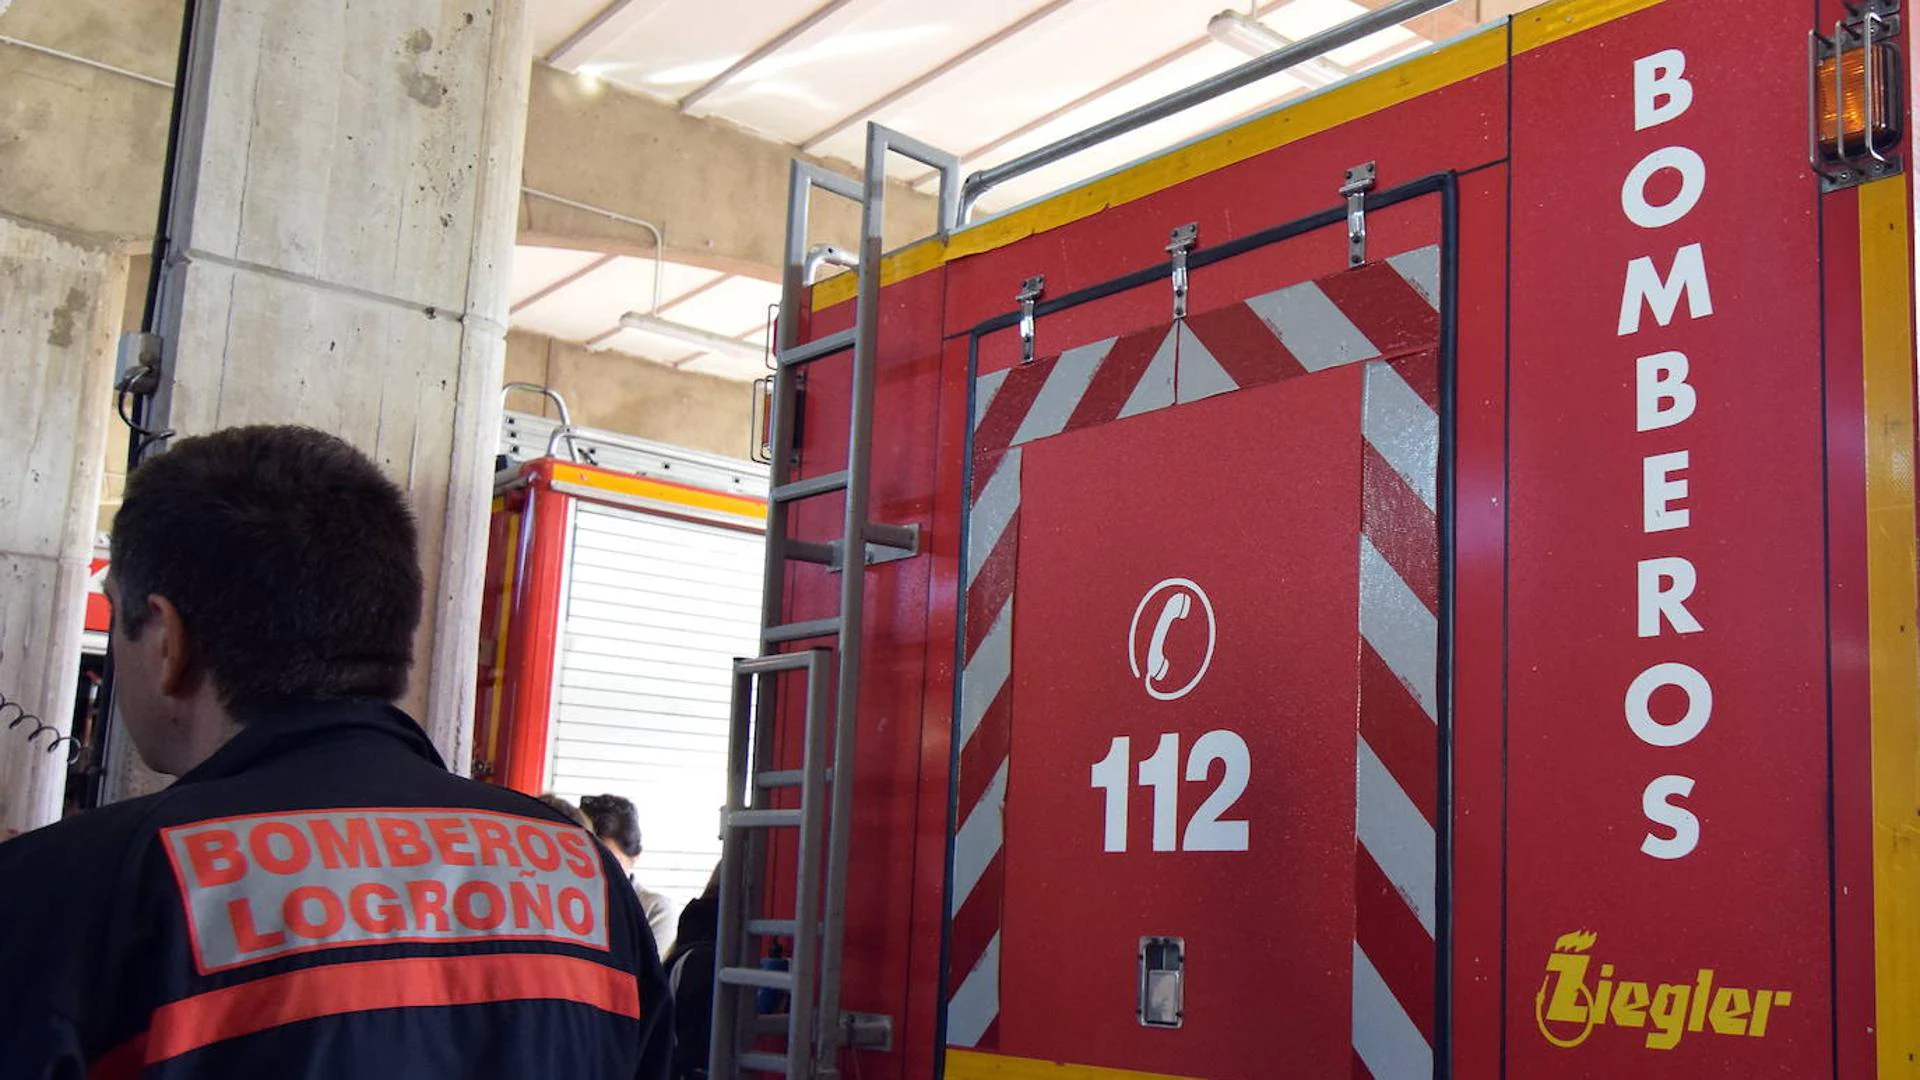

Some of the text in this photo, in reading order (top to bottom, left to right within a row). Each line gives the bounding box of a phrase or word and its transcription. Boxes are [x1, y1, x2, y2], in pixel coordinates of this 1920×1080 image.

[1617, 48, 1714, 860] BOMBEROS
[1090, 729, 1252, 853] 112
[182, 819, 597, 888] BOMBEROS
[227, 870, 594, 954] LOGROÑO
[1537, 942, 1792, 1050] Ziegler
